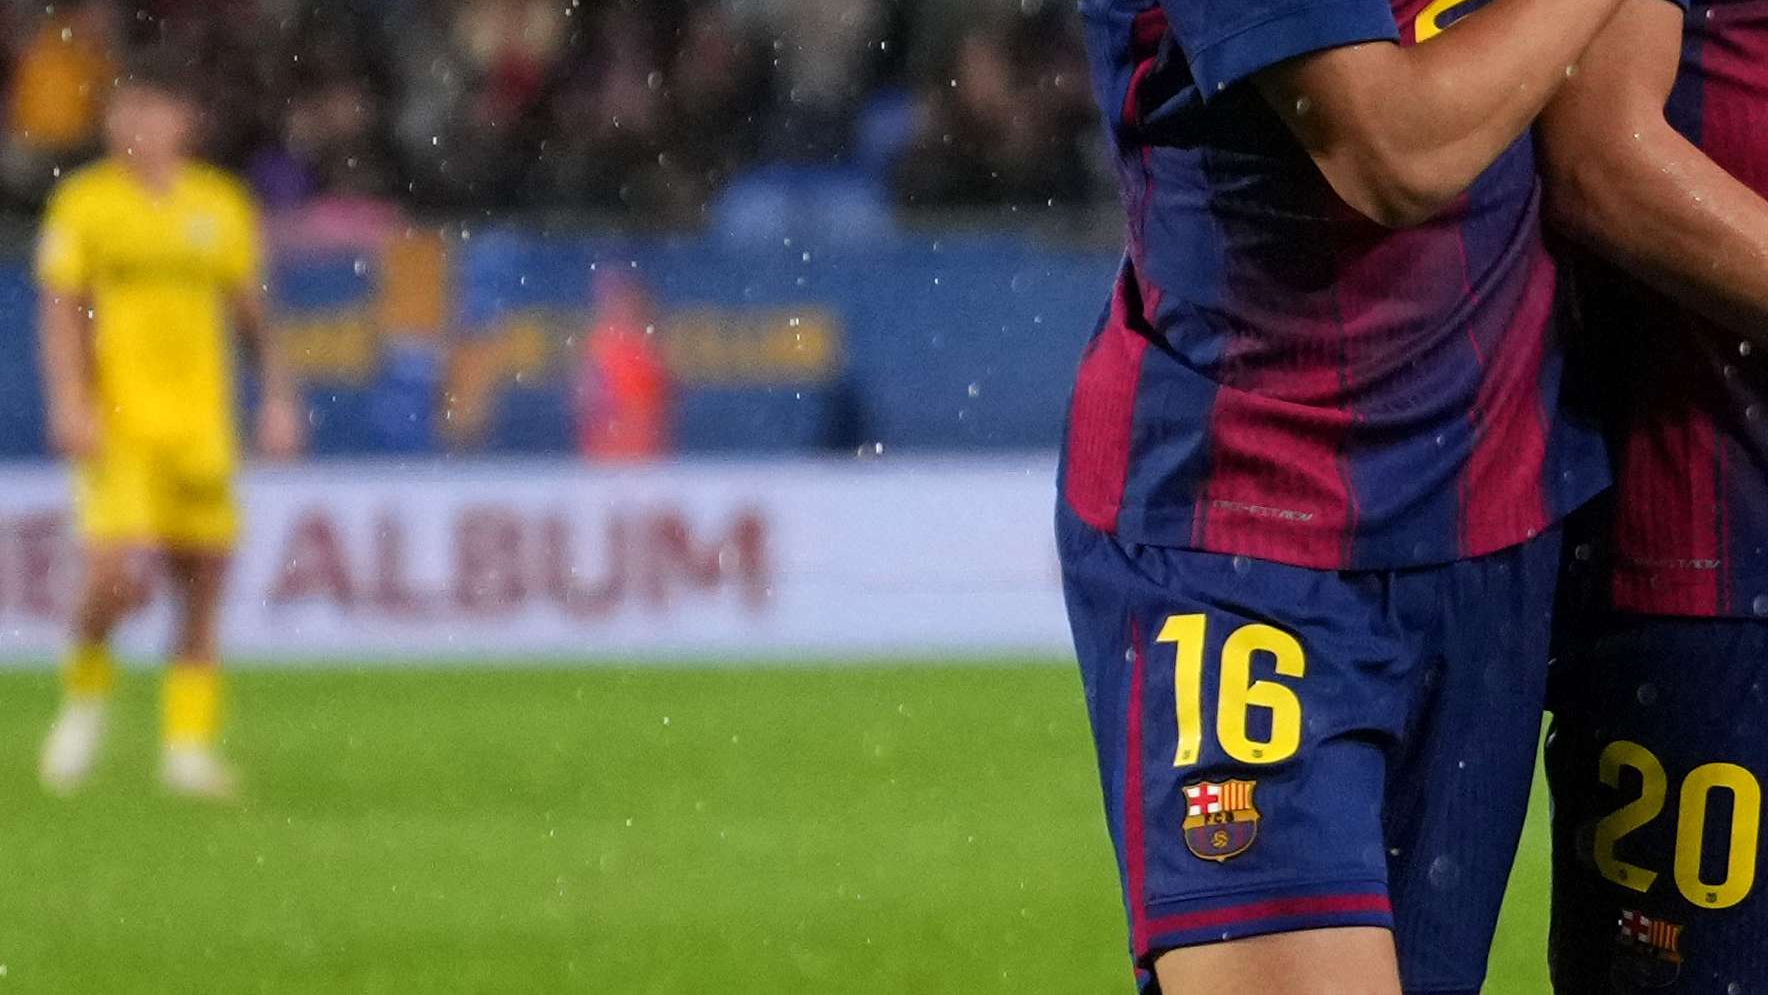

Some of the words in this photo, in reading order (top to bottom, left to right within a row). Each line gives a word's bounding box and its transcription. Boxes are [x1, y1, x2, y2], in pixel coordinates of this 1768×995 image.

[266, 500, 772, 618] ALBUM
[1156, 613, 1306, 766] 16
[1593, 740, 1761, 909] 20
